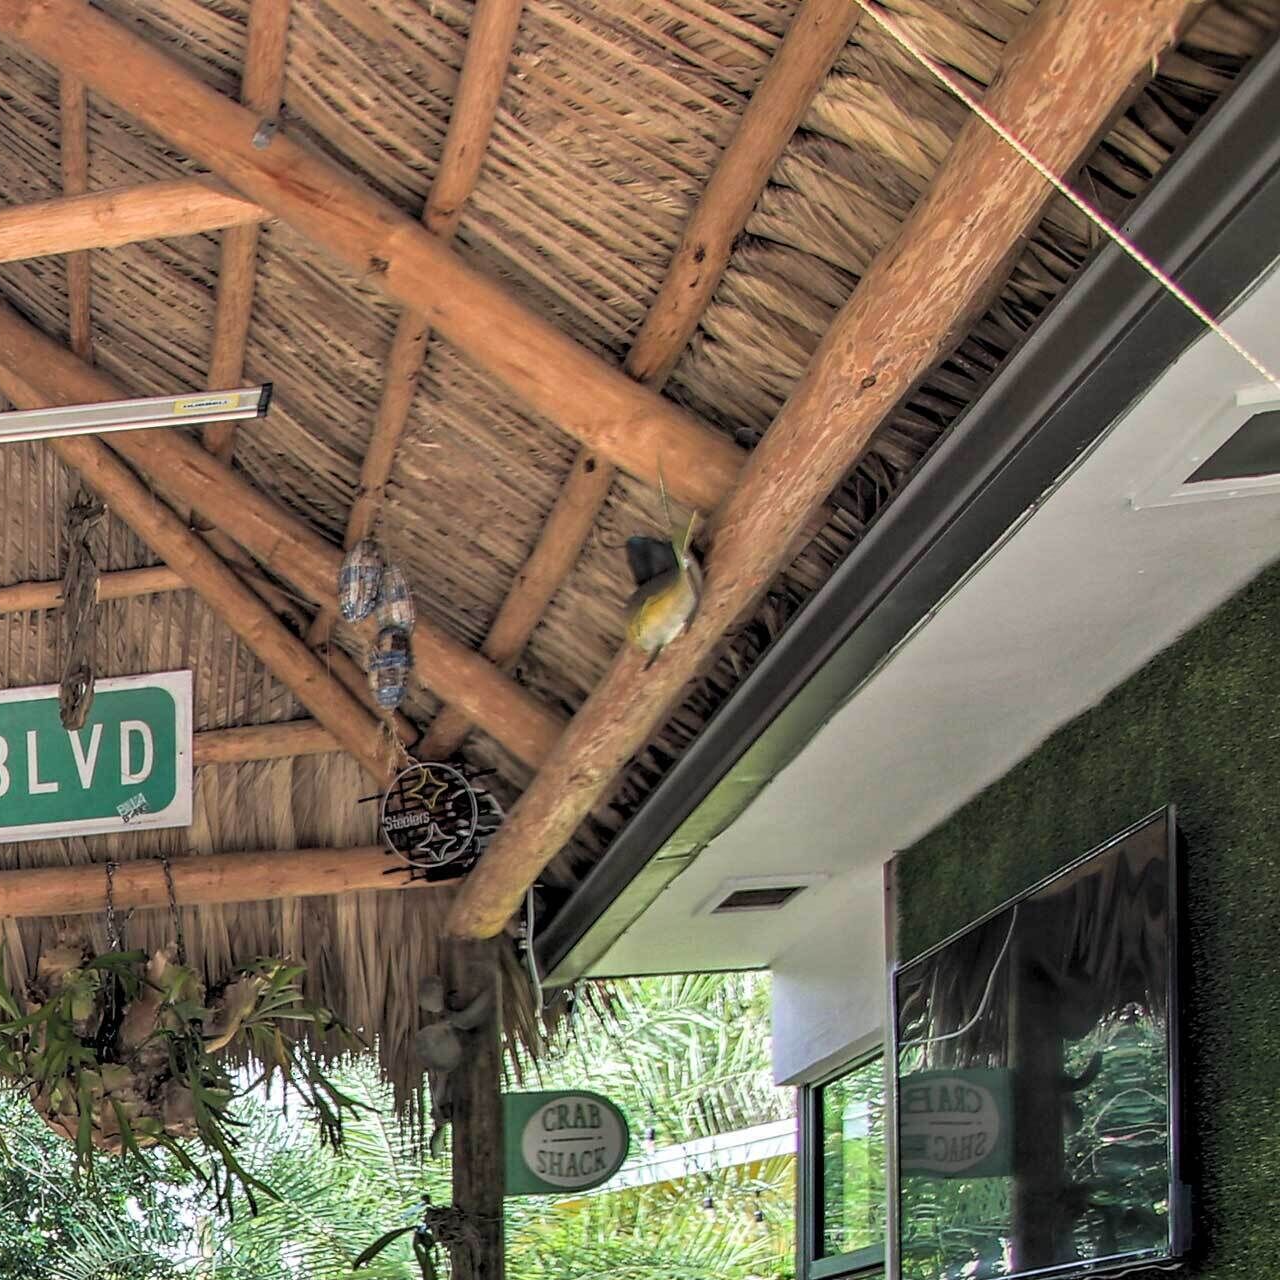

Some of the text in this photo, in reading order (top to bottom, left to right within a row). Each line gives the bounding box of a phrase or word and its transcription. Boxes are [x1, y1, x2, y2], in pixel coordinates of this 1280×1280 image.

[383, 810, 431, 832] Steelers
[542, 1103, 602, 1132] CRAB
[537, 1147, 606, 1178] SHACK
